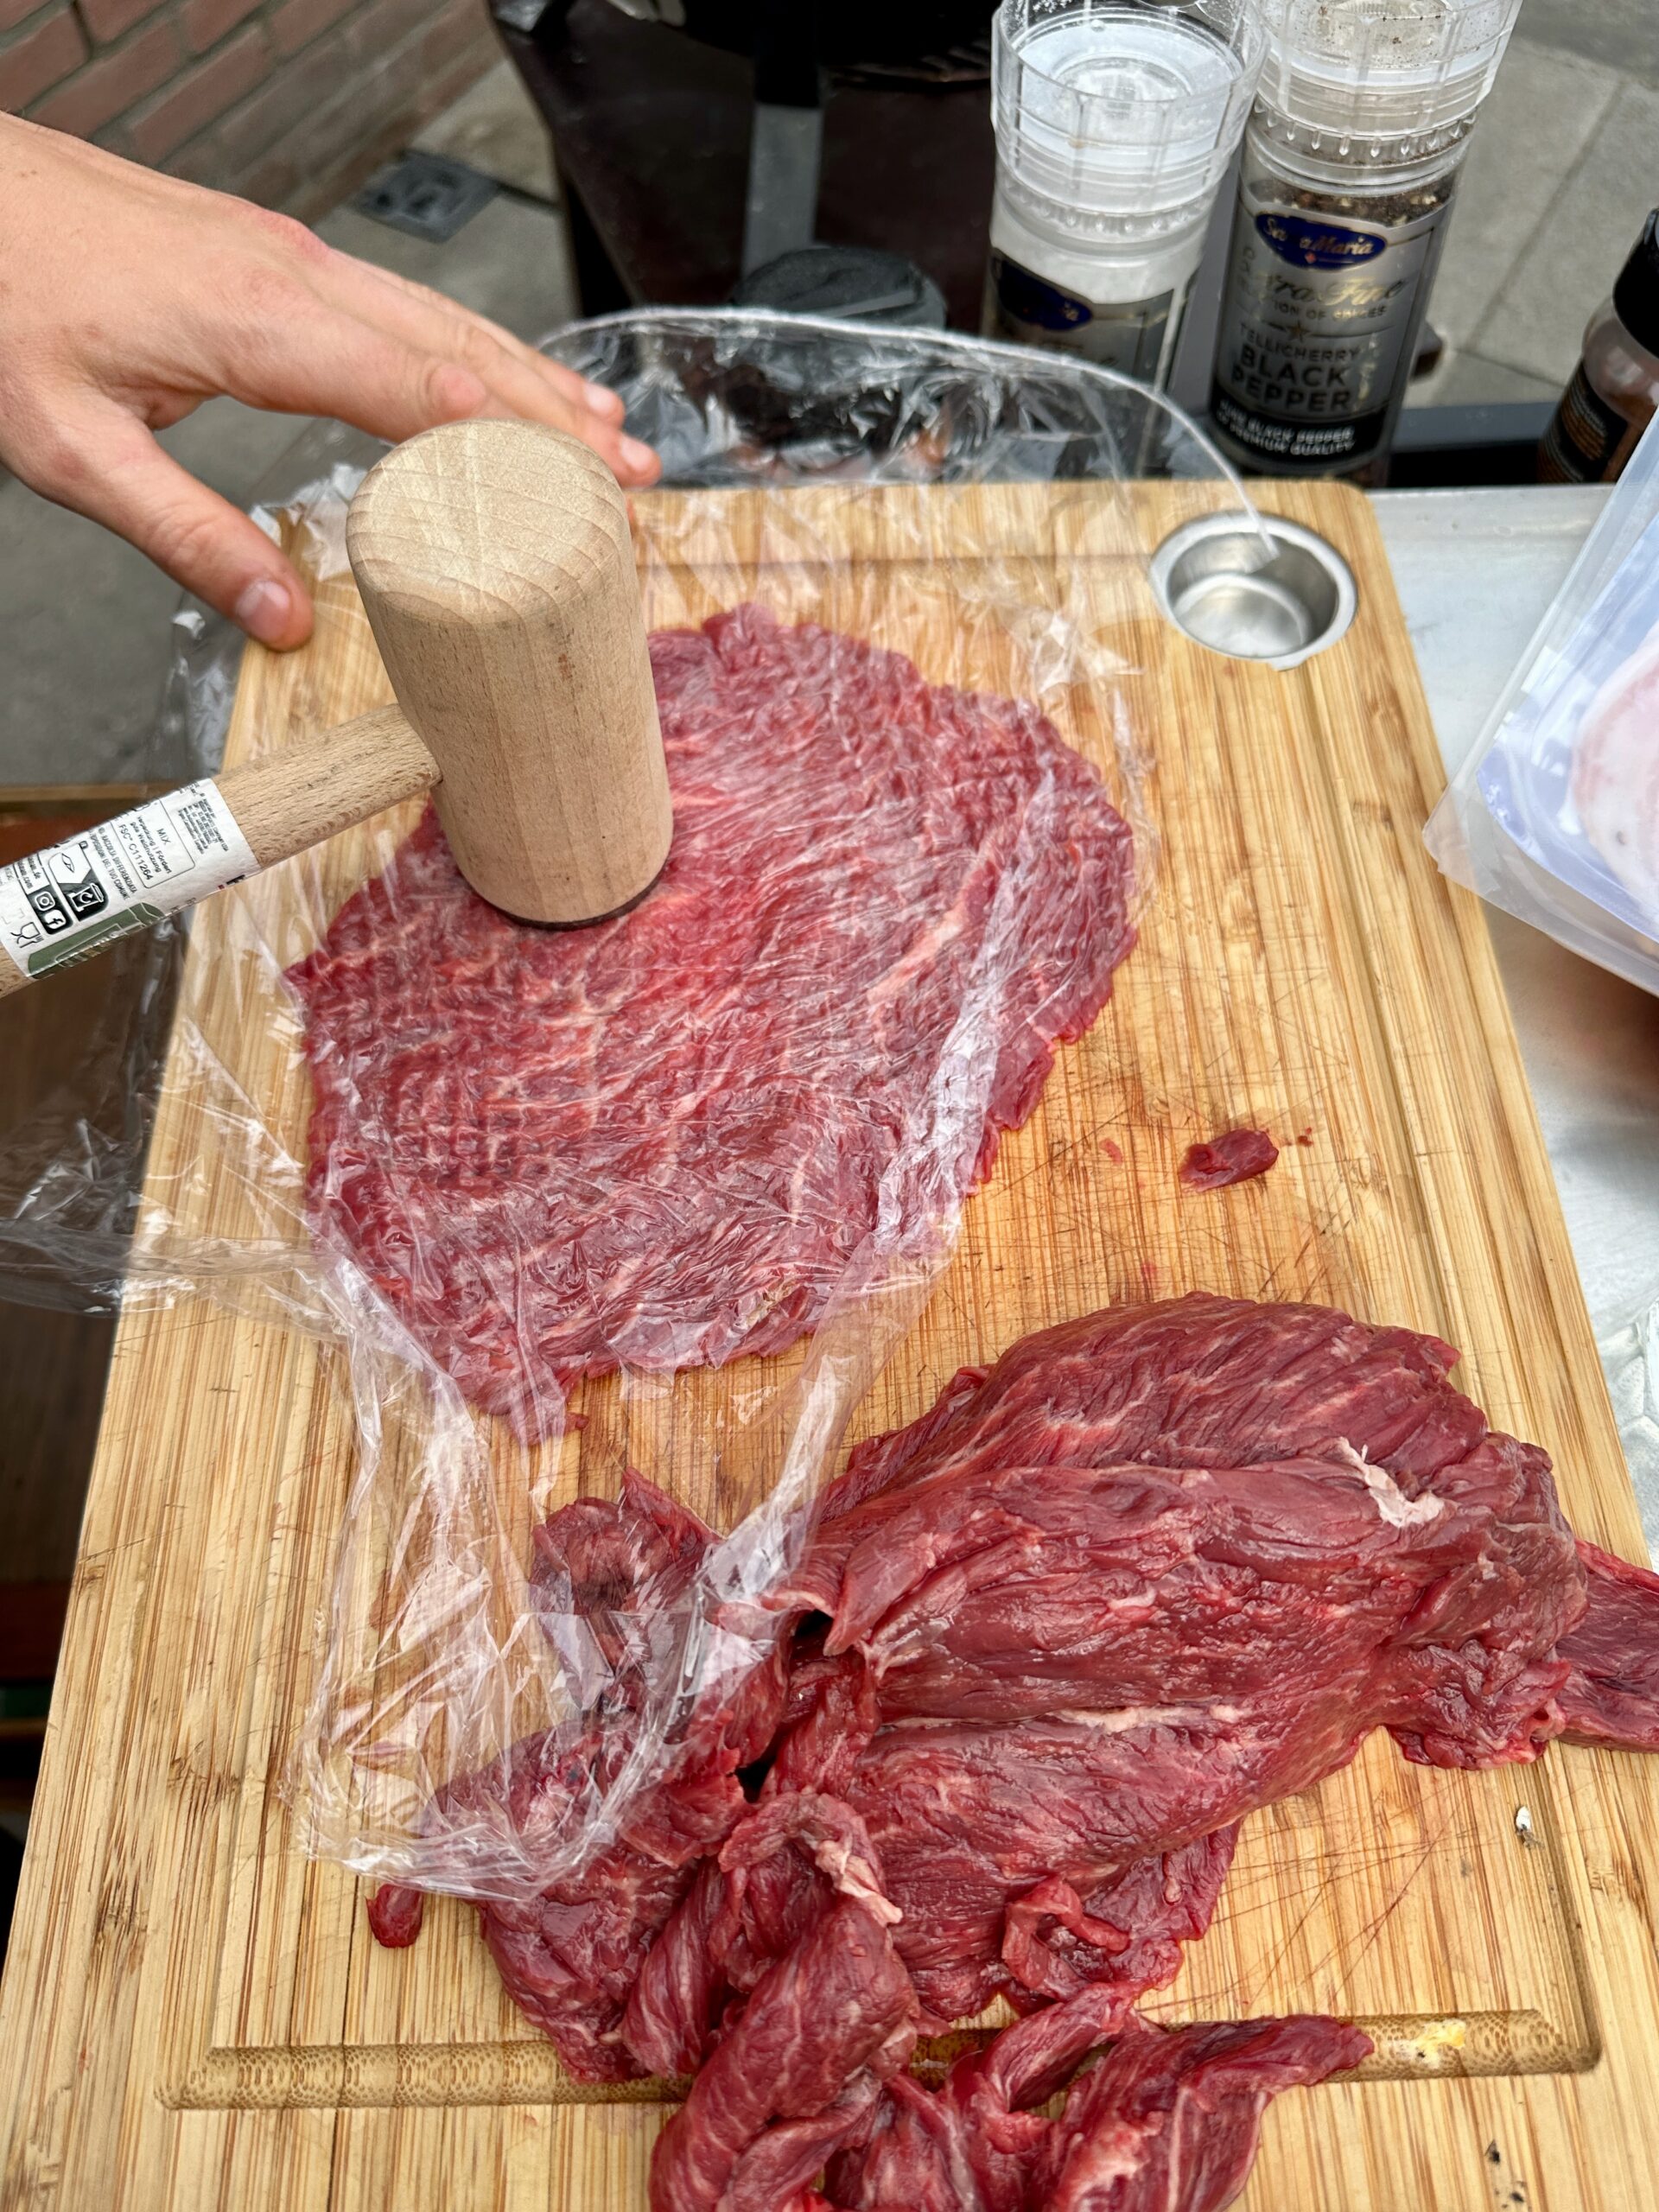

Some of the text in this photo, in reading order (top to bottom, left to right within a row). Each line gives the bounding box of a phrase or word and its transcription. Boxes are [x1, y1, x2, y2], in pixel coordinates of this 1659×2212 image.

[1312, 236, 1376, 256] Maria
[1241, 323, 1360, 363] TELLICHERRY
[1240, 346, 1349, 387] BLACK
[1232, 364, 1352, 412] PEPPER
[138, 834, 162, 873] Waldnutzung
[156, 828, 171, 845] MIX
[129, 843, 154, 880] C111264
[155, 850, 172, 874] Fördert
